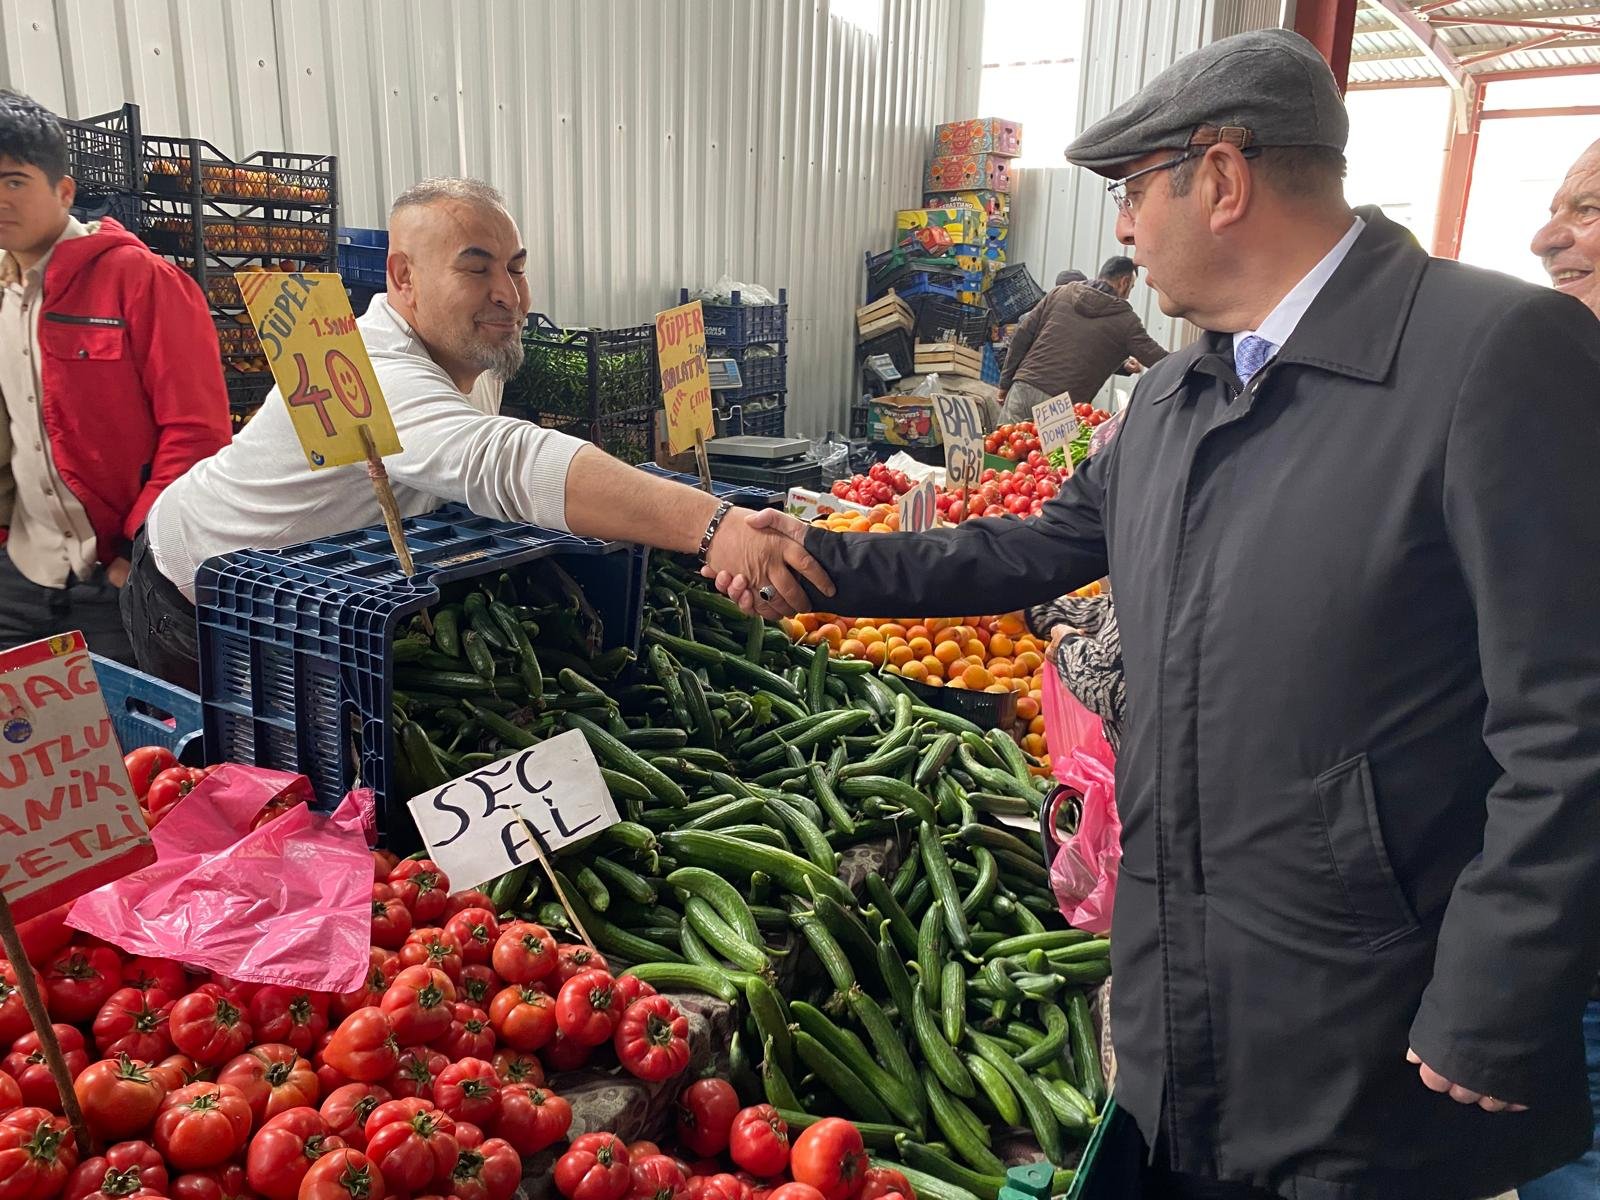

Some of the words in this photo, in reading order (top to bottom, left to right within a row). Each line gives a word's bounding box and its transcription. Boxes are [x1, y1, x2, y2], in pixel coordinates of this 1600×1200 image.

[259, 273, 320, 362] SÜPER
[657, 307, 704, 353] SÜPER
[288, 349, 373, 437] 40
[936, 395, 982, 441] BAL
[1035, 396, 1072, 427] PEMBE
[902, 481, 936, 532] 100
[432, 750, 552, 847] SEÇ
[501, 808, 601, 865] AL
